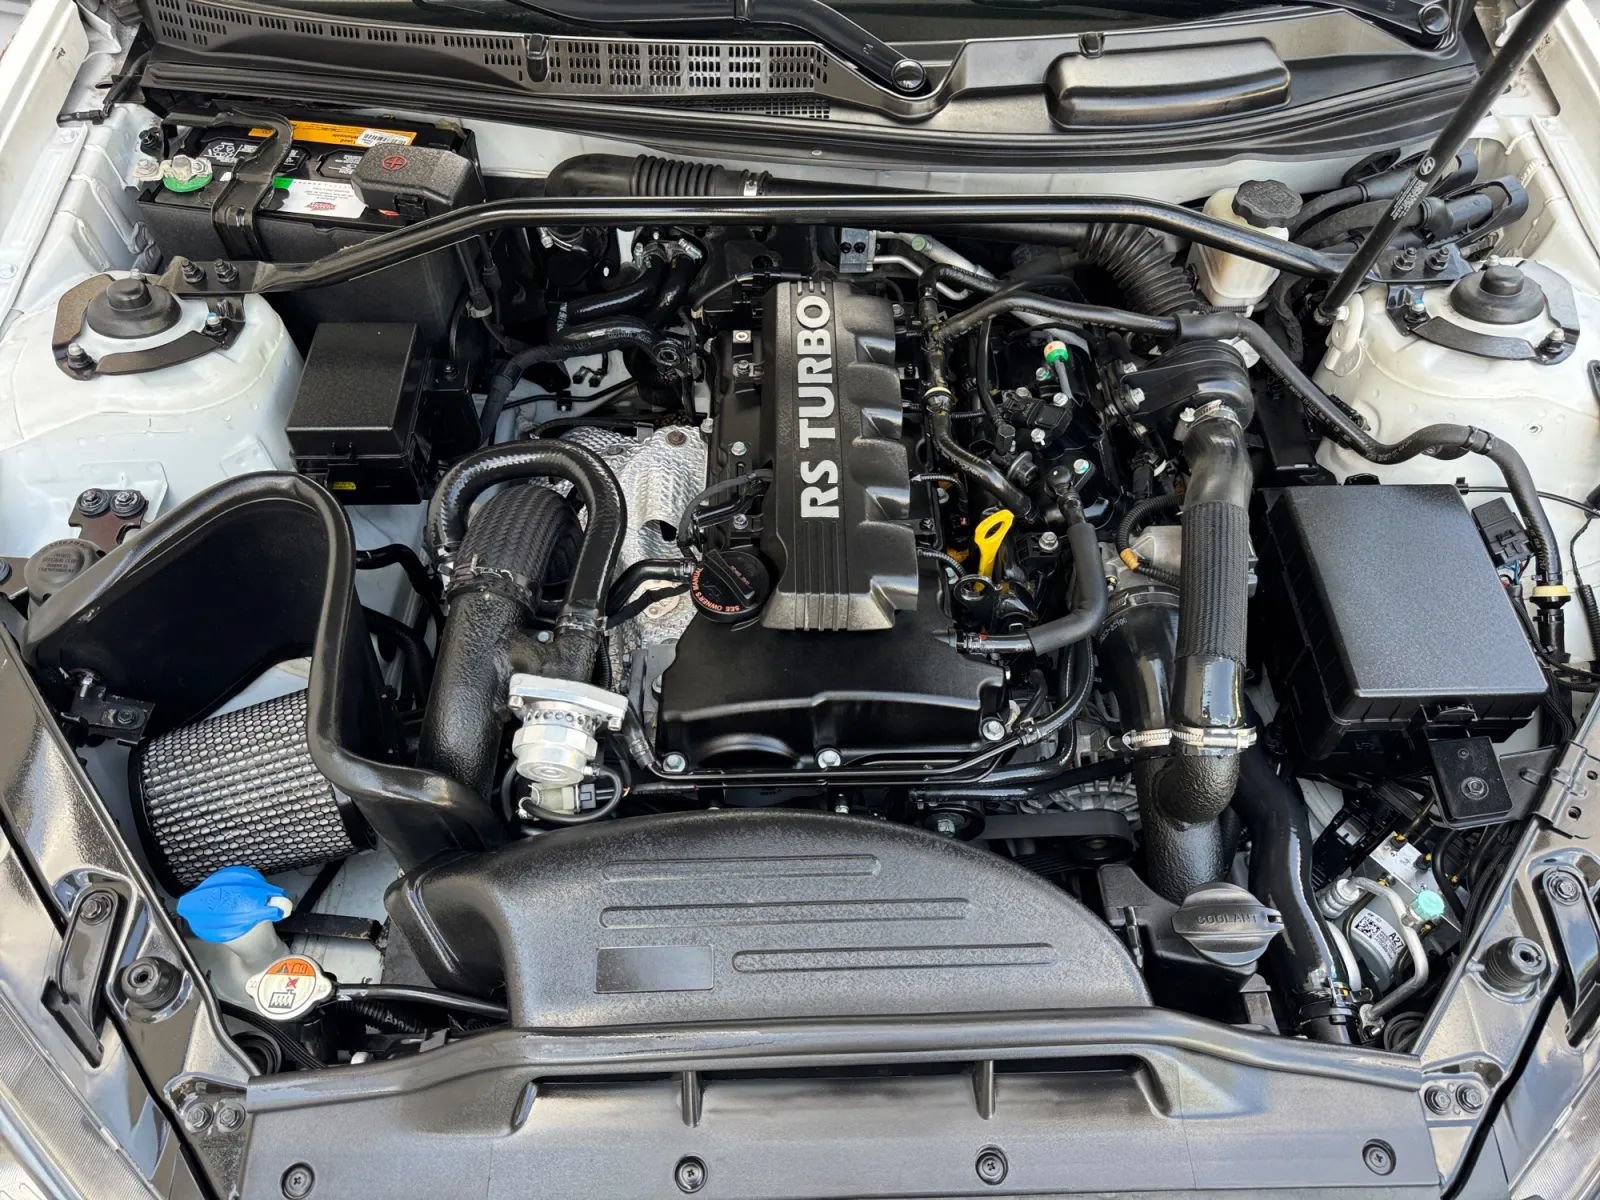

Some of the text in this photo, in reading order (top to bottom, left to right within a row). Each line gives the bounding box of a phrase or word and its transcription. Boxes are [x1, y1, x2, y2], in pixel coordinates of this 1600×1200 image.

[796, 295, 839, 518] RS TURBO
[695, 591, 723, 611] OWNER'S
[1196, 912, 1257, 925] COOLANT
[1388, 932, 1405, 949] A27
